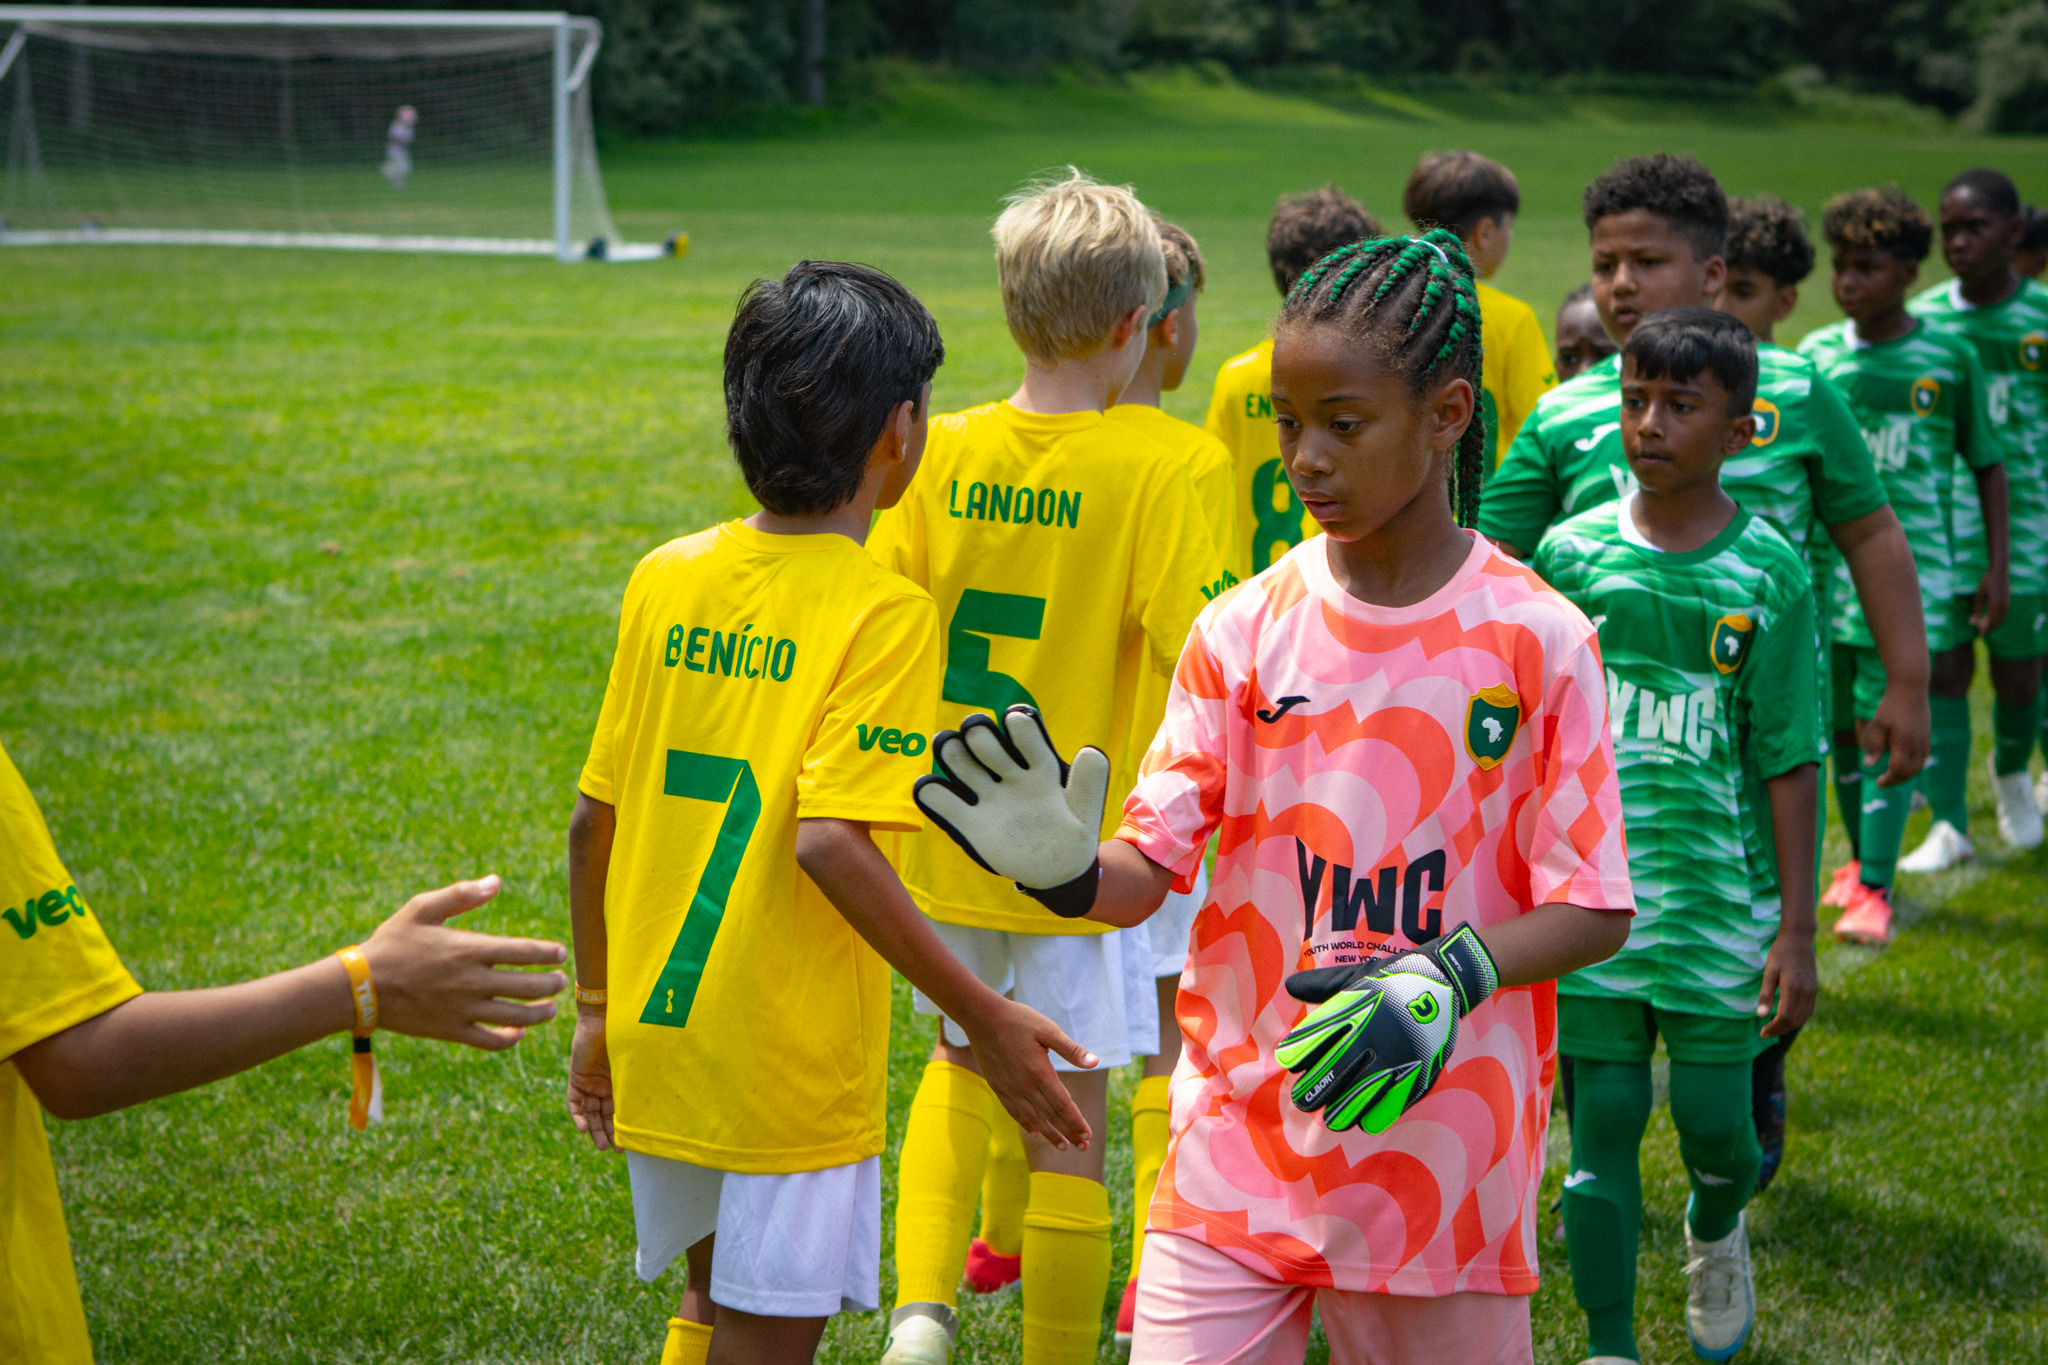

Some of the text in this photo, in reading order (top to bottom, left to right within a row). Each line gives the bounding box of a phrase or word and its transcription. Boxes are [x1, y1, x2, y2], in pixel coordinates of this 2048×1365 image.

[1246, 393, 1278, 418] EN
[949, 480, 1082, 529] LANDON
[1252, 458, 1306, 576] 8
[665, 623, 797, 683] BENÍCIO
[932, 588, 1046, 780] 5
[1606, 666, 1717, 761] YWC
[856, 724, 927, 757] veo
[638, 749, 762, 1029] 7
[1295, 836, 1446, 945] YWC
[1303, 941, 1410, 958] YOUTH WORLD CHALLE
[1335, 955, 1357, 963] NEW
